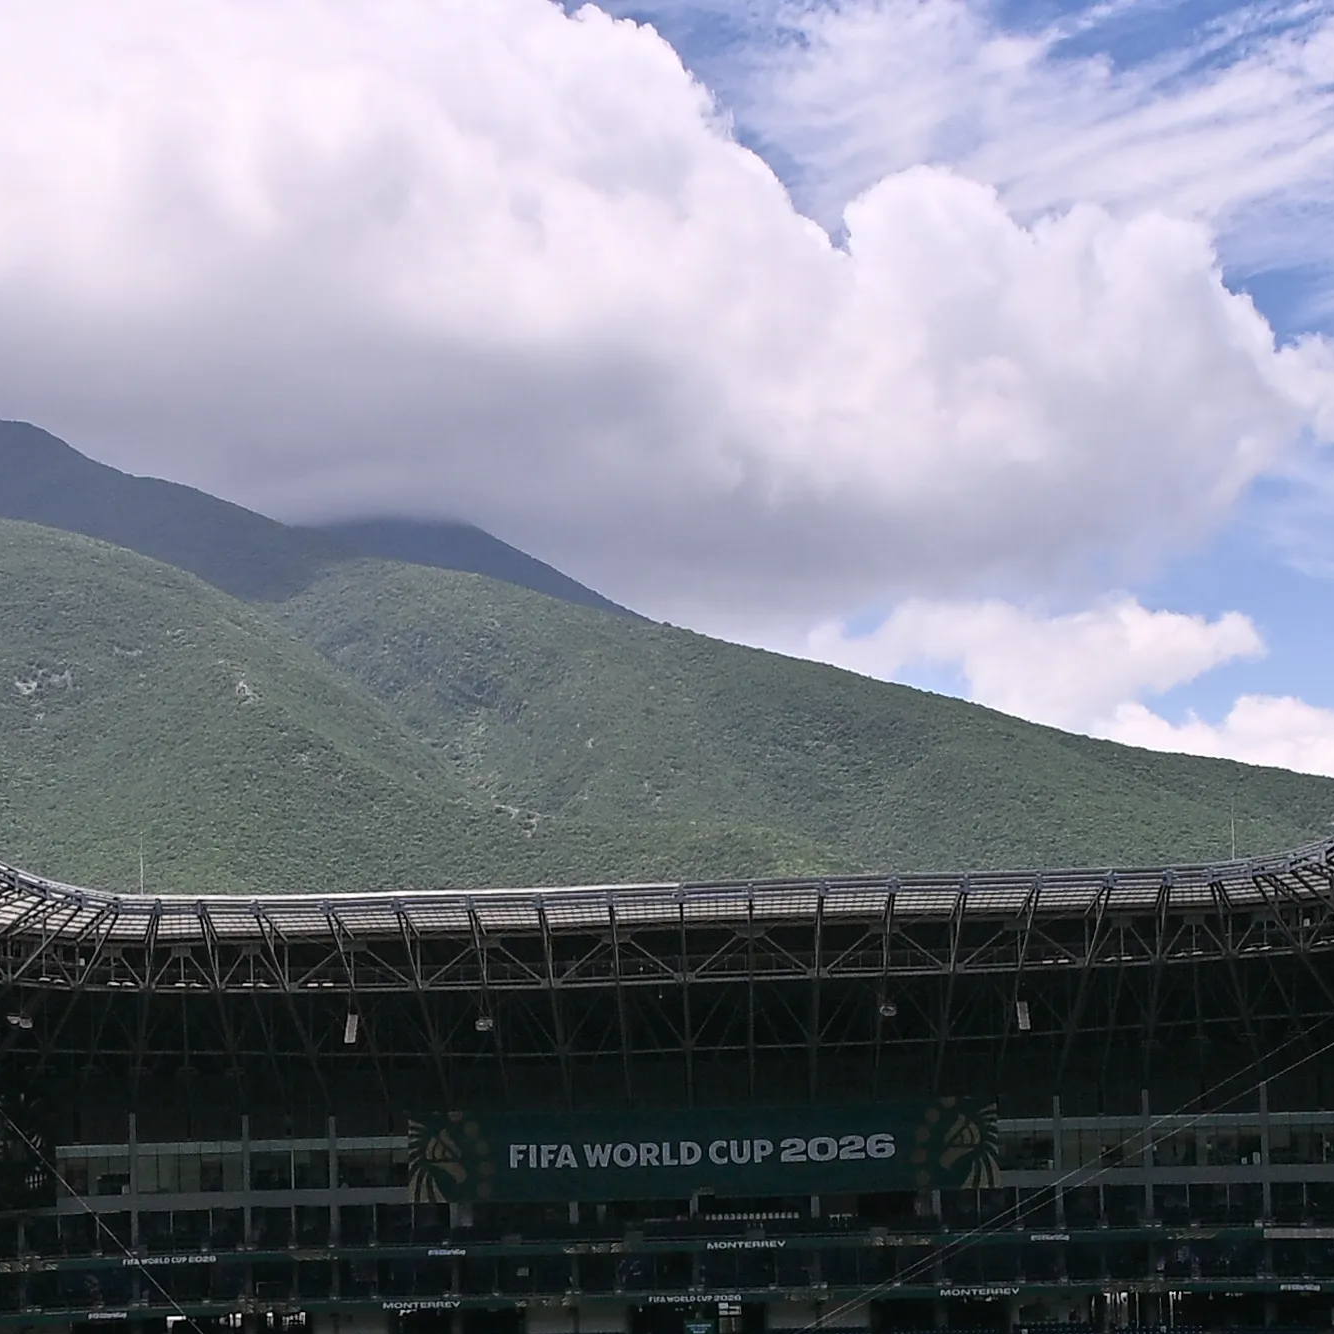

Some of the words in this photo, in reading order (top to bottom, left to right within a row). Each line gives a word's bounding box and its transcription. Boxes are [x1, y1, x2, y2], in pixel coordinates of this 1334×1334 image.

[509, 1144, 578, 1168] FIFA
[583, 1140, 702, 1167] WORLD
[708, 1138, 774, 1165] CUP
[780, 1133, 896, 1163] 2026
[706, 1240, 786, 1250] MONTERREY
[939, 1287, 1020, 1297] MONTERREY
[382, 1300, 460, 1310] MONTERREY
